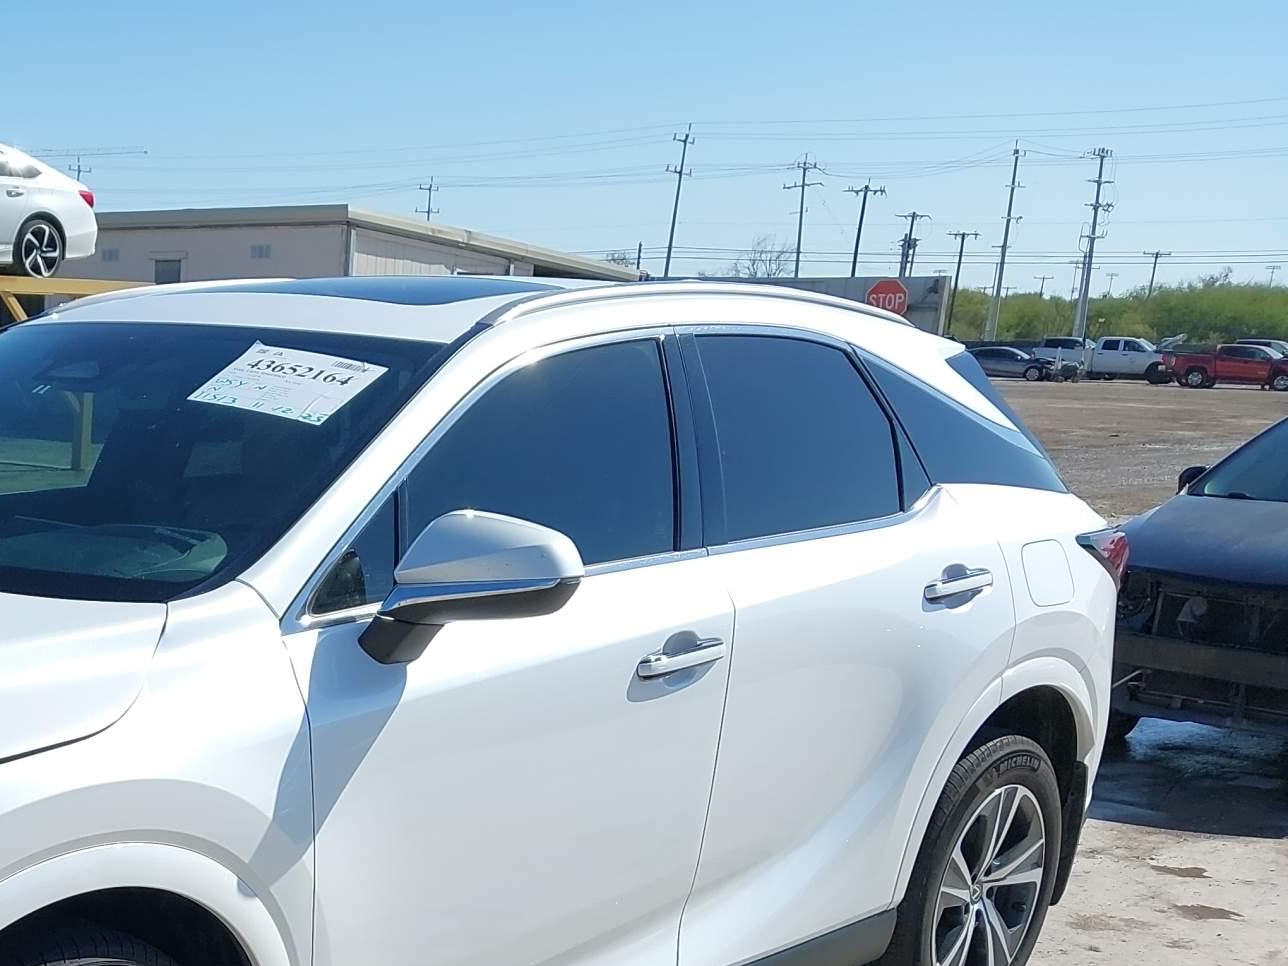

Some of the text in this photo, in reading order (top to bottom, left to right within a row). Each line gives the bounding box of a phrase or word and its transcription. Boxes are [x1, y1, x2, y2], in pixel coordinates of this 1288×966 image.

[869, 294, 904, 309] STOP
[247, 359, 354, 386] 43652164
[999, 754, 1040, 773] MICHELIN
